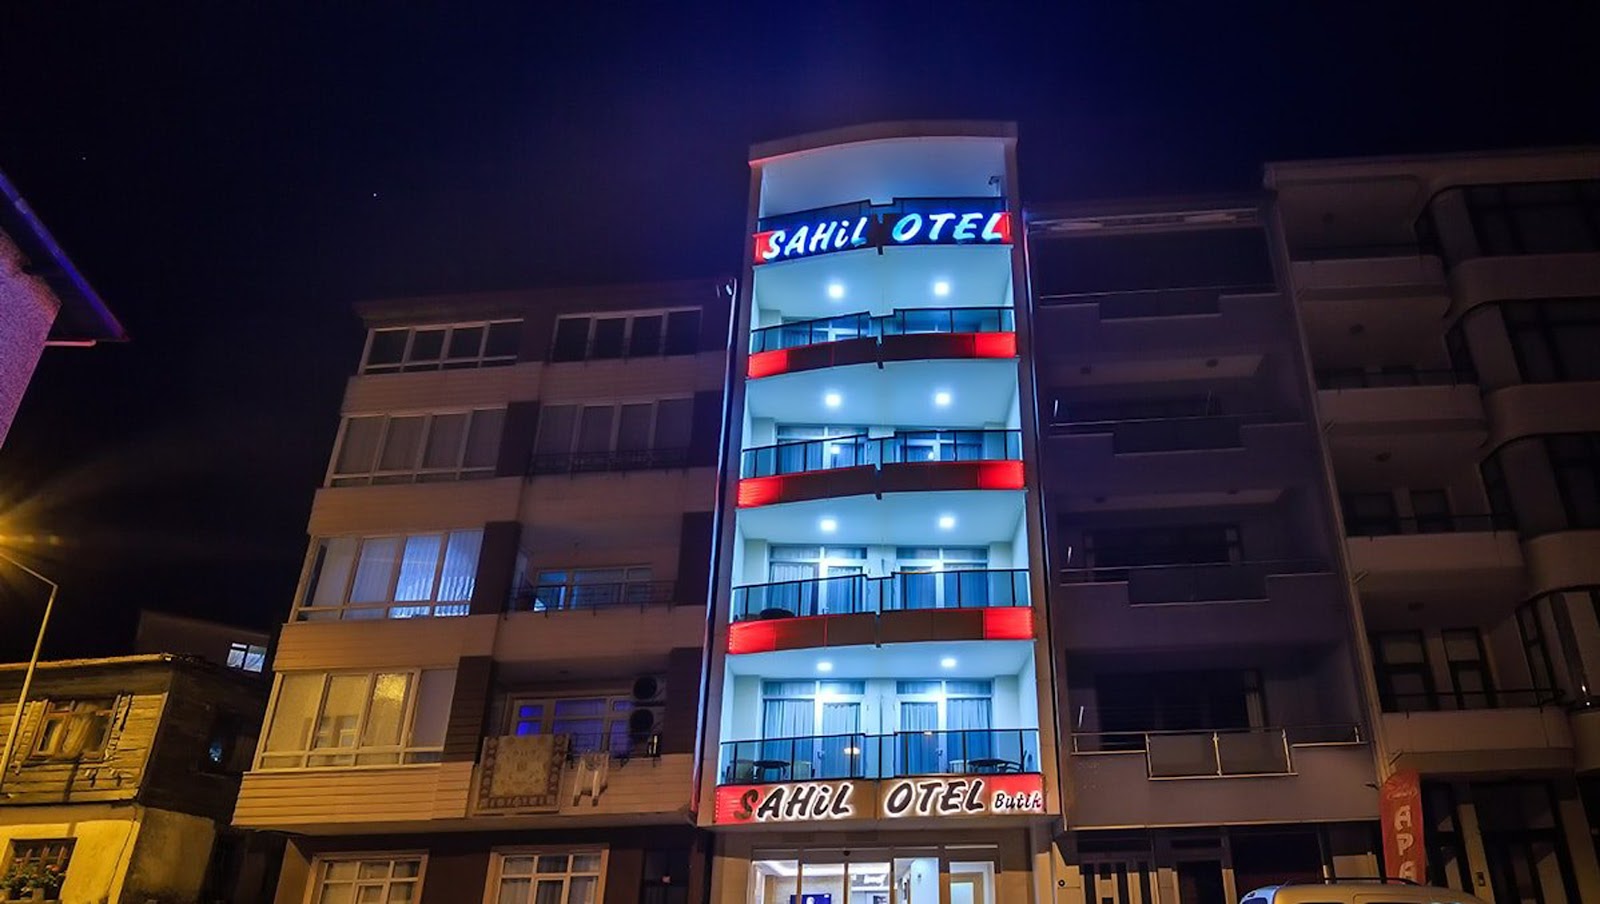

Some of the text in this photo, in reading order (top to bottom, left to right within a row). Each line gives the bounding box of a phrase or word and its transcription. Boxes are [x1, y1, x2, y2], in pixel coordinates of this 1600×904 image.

[892, 212, 1004, 242] OTEL
[884, 778, 985, 816] OTEL
[993, 791, 1042, 811] Butik
